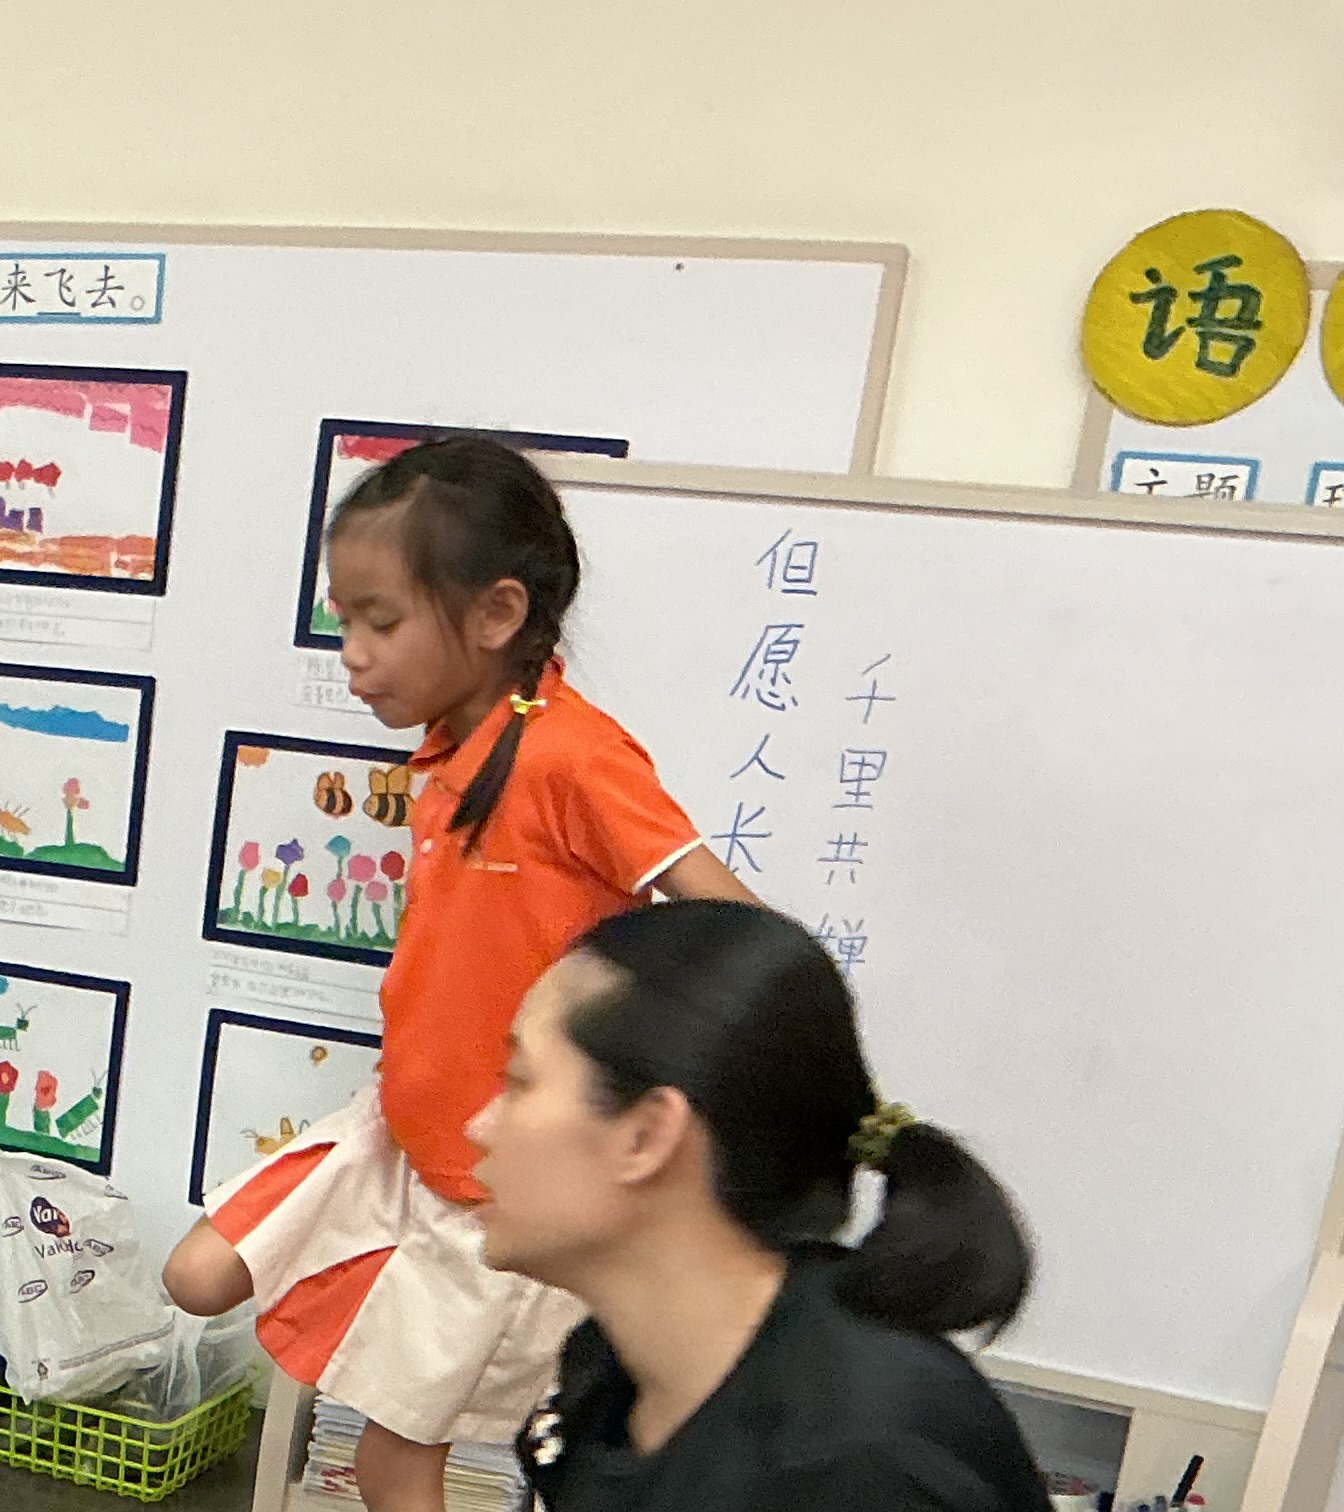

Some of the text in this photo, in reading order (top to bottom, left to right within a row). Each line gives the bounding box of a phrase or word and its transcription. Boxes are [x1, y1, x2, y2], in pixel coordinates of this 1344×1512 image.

[1129, 254, 1263, 378] 语
[711, 529, 819, 873] 但愿人长
